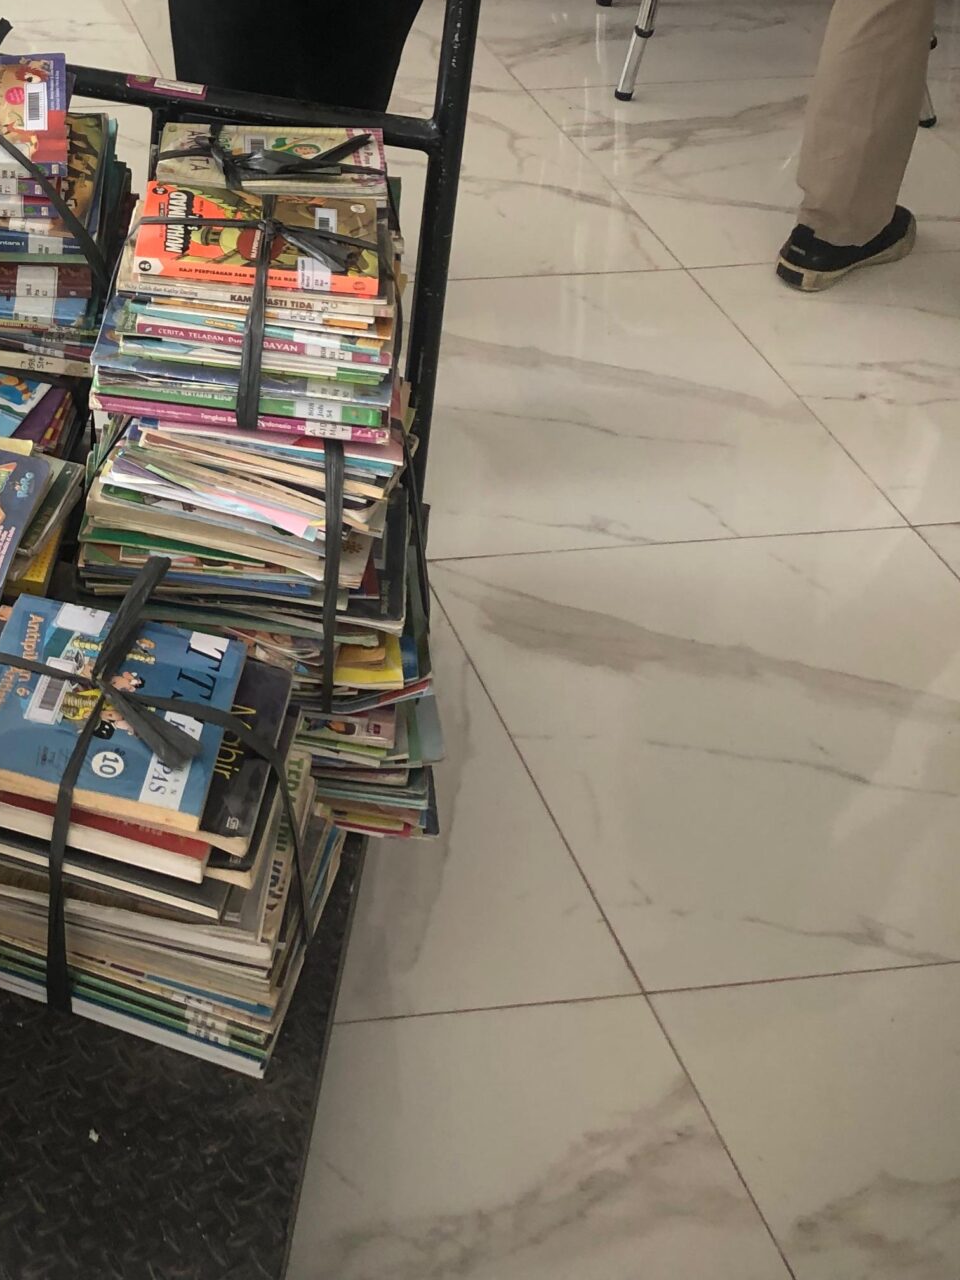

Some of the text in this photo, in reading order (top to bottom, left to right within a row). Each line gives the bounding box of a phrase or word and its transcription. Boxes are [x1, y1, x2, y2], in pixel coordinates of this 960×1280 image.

[166, 191, 189, 253] MUHAMAD
[230, 294, 253, 303] KAM
[158, 329, 185, 337] CERITA
[189, 332, 224, 341] TELADAN
[99, 753, 119, 775] 10
